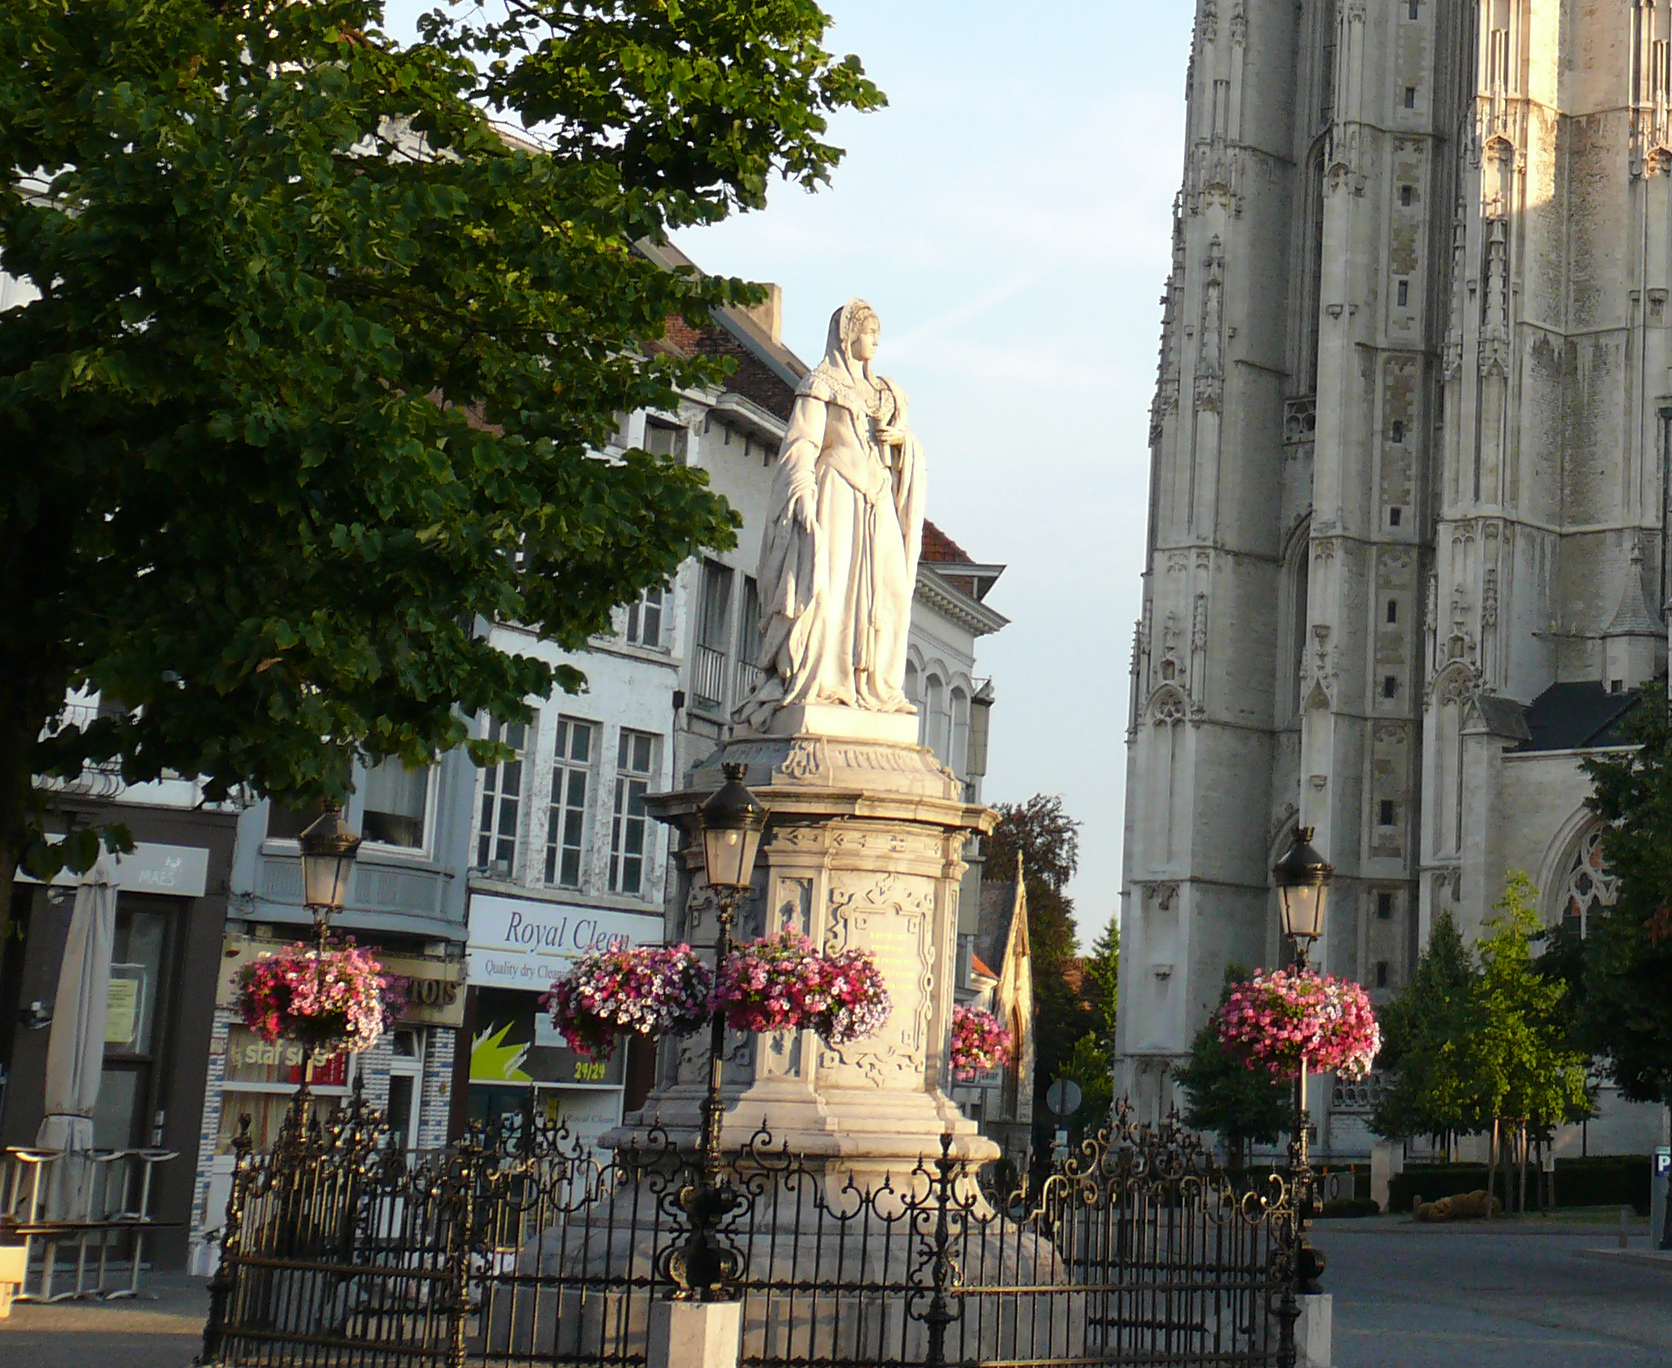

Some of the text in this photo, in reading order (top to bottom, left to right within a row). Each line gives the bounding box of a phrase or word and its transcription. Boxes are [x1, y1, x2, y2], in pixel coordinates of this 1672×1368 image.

[505, 911, 631, 953] Royal Clean
[485, 959, 519, 981] Quality
[520, 963, 536, 980] dry
[245, 1038, 284, 1066] staf
[574, 1061, 606, 1081] 24/24
[1658, 1154, 1671, 1172] P
